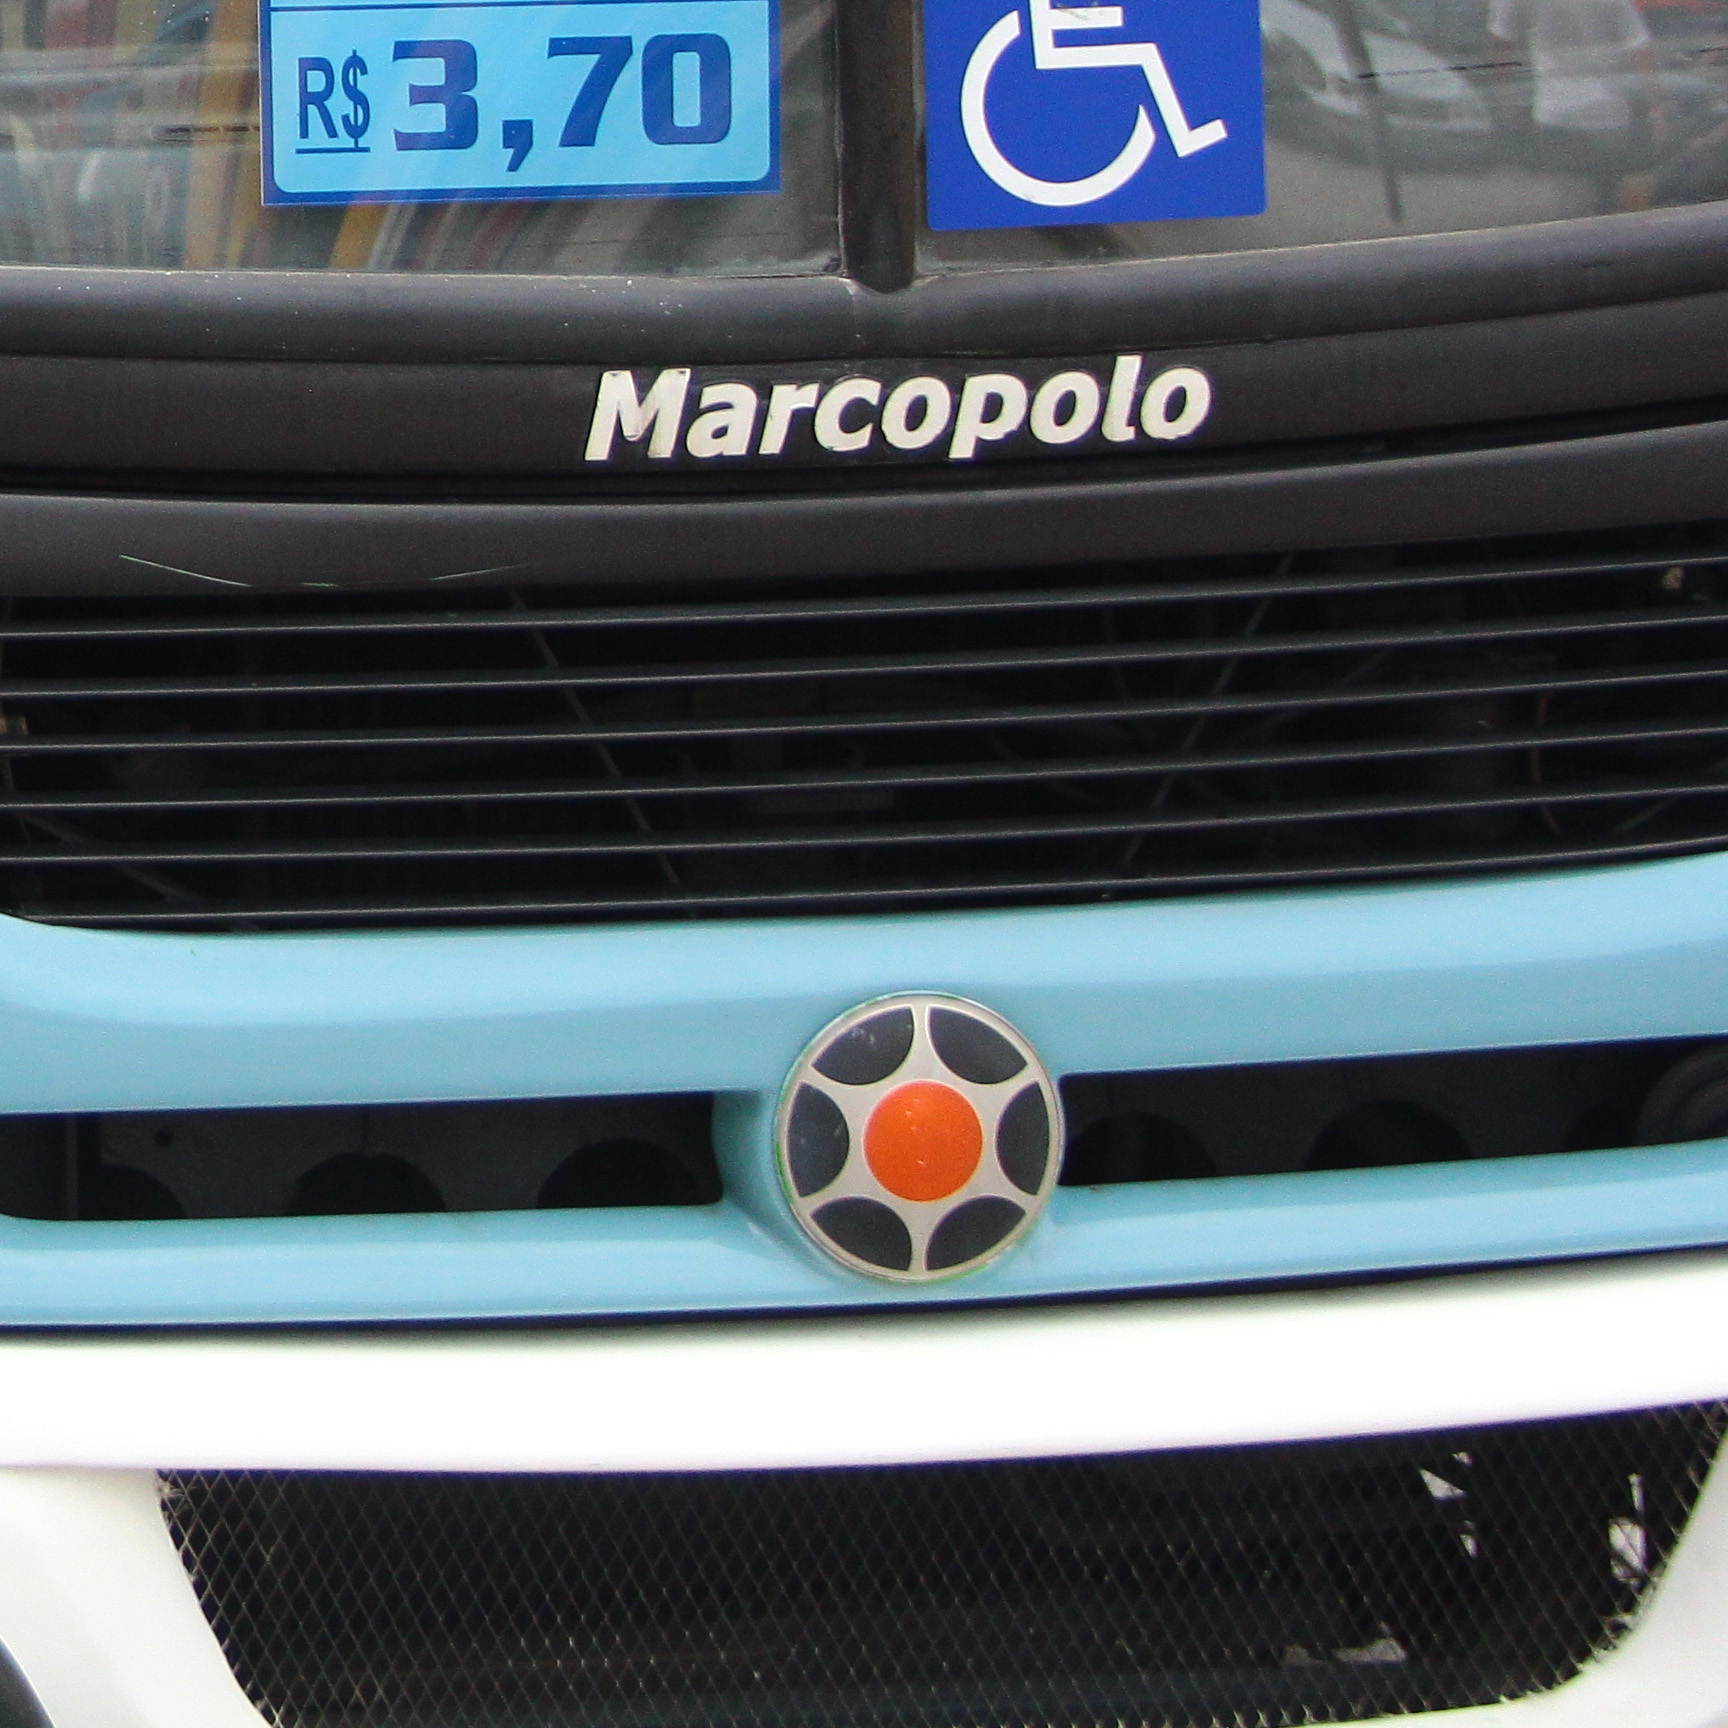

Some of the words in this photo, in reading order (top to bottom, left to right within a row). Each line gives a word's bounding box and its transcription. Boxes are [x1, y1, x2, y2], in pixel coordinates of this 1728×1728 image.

[295, 50, 371, 149] R$
[391, 32, 732, 172] 3,70
[583, 354, 1212, 461] Marcopolo
